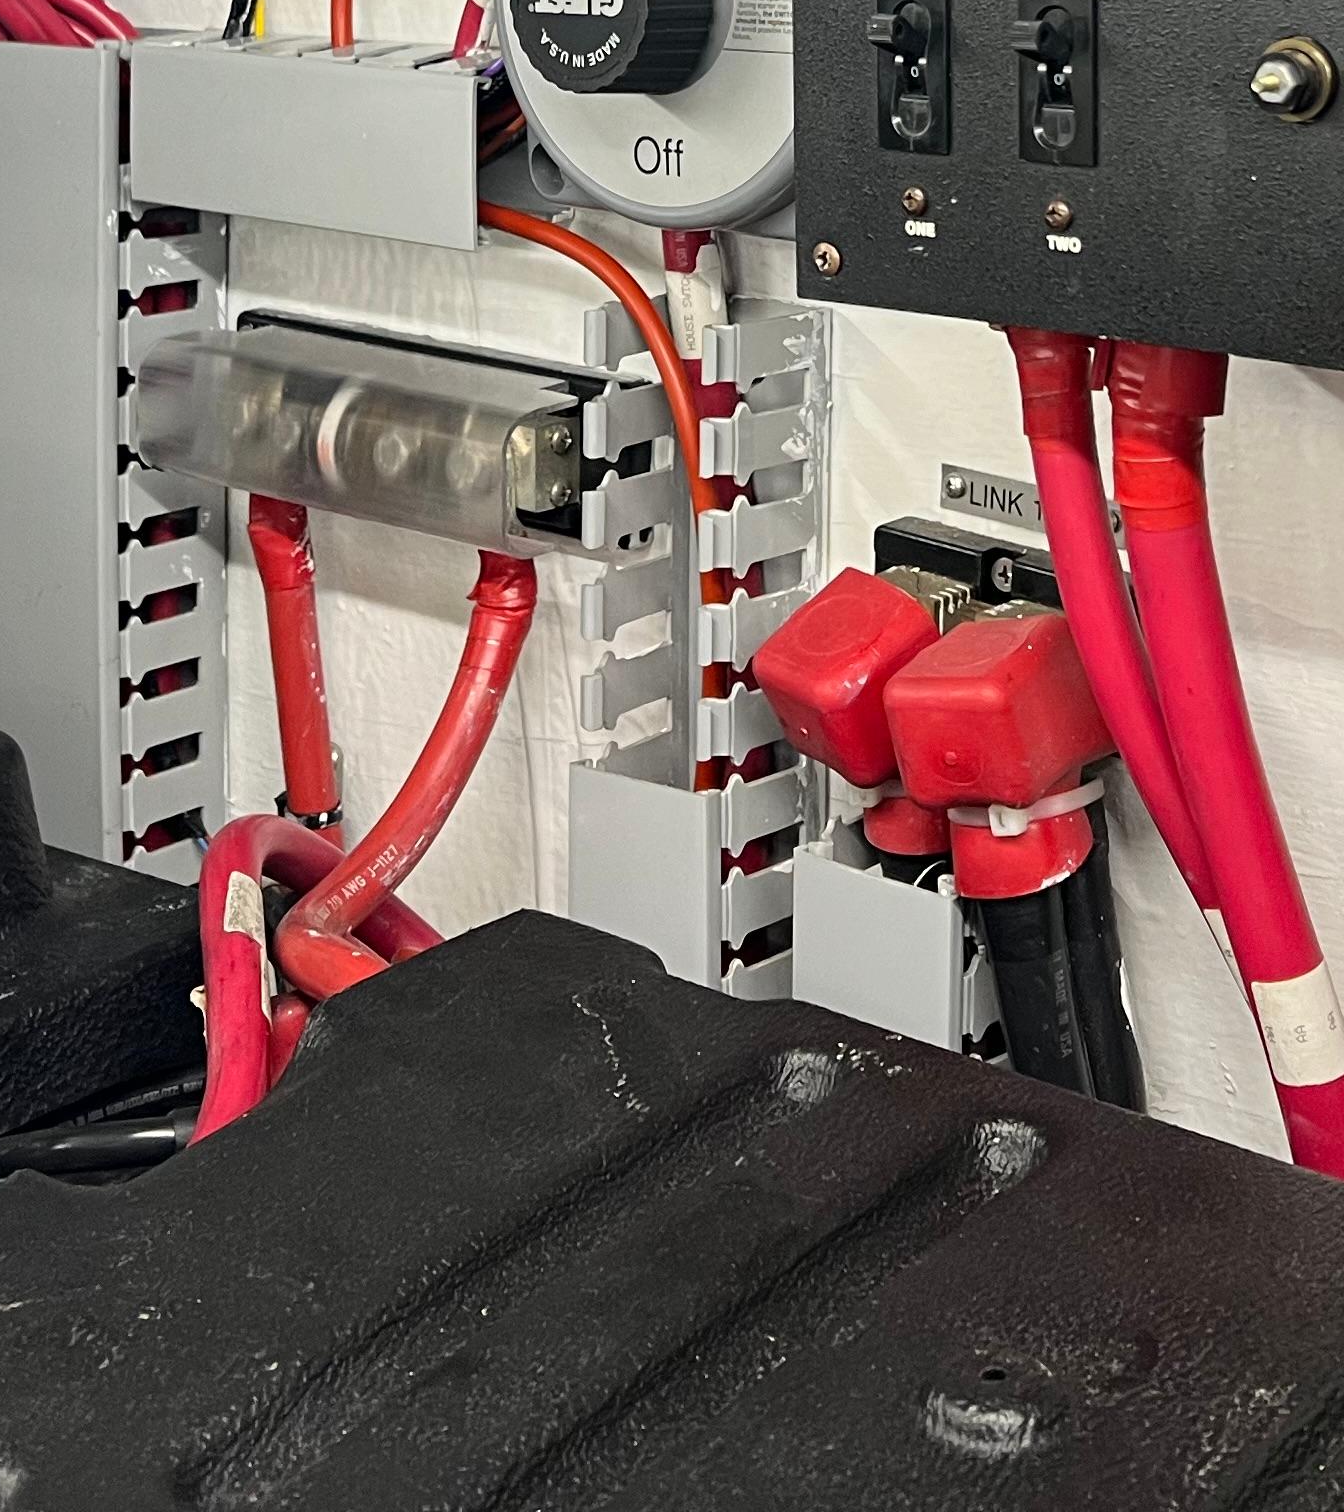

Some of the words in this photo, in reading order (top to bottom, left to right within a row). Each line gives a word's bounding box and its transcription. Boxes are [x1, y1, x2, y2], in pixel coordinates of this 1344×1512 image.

[573, 54, 585, 67] IN
[589, 32, 620, 67] MADE
[634, 136, 683, 177] Off
[905, 220, 935, 237] ONE
[1046, 235, 1081, 253] TWO
[684, 315, 696, 351] HOUSE
[970, 481, 1024, 516] LINK
